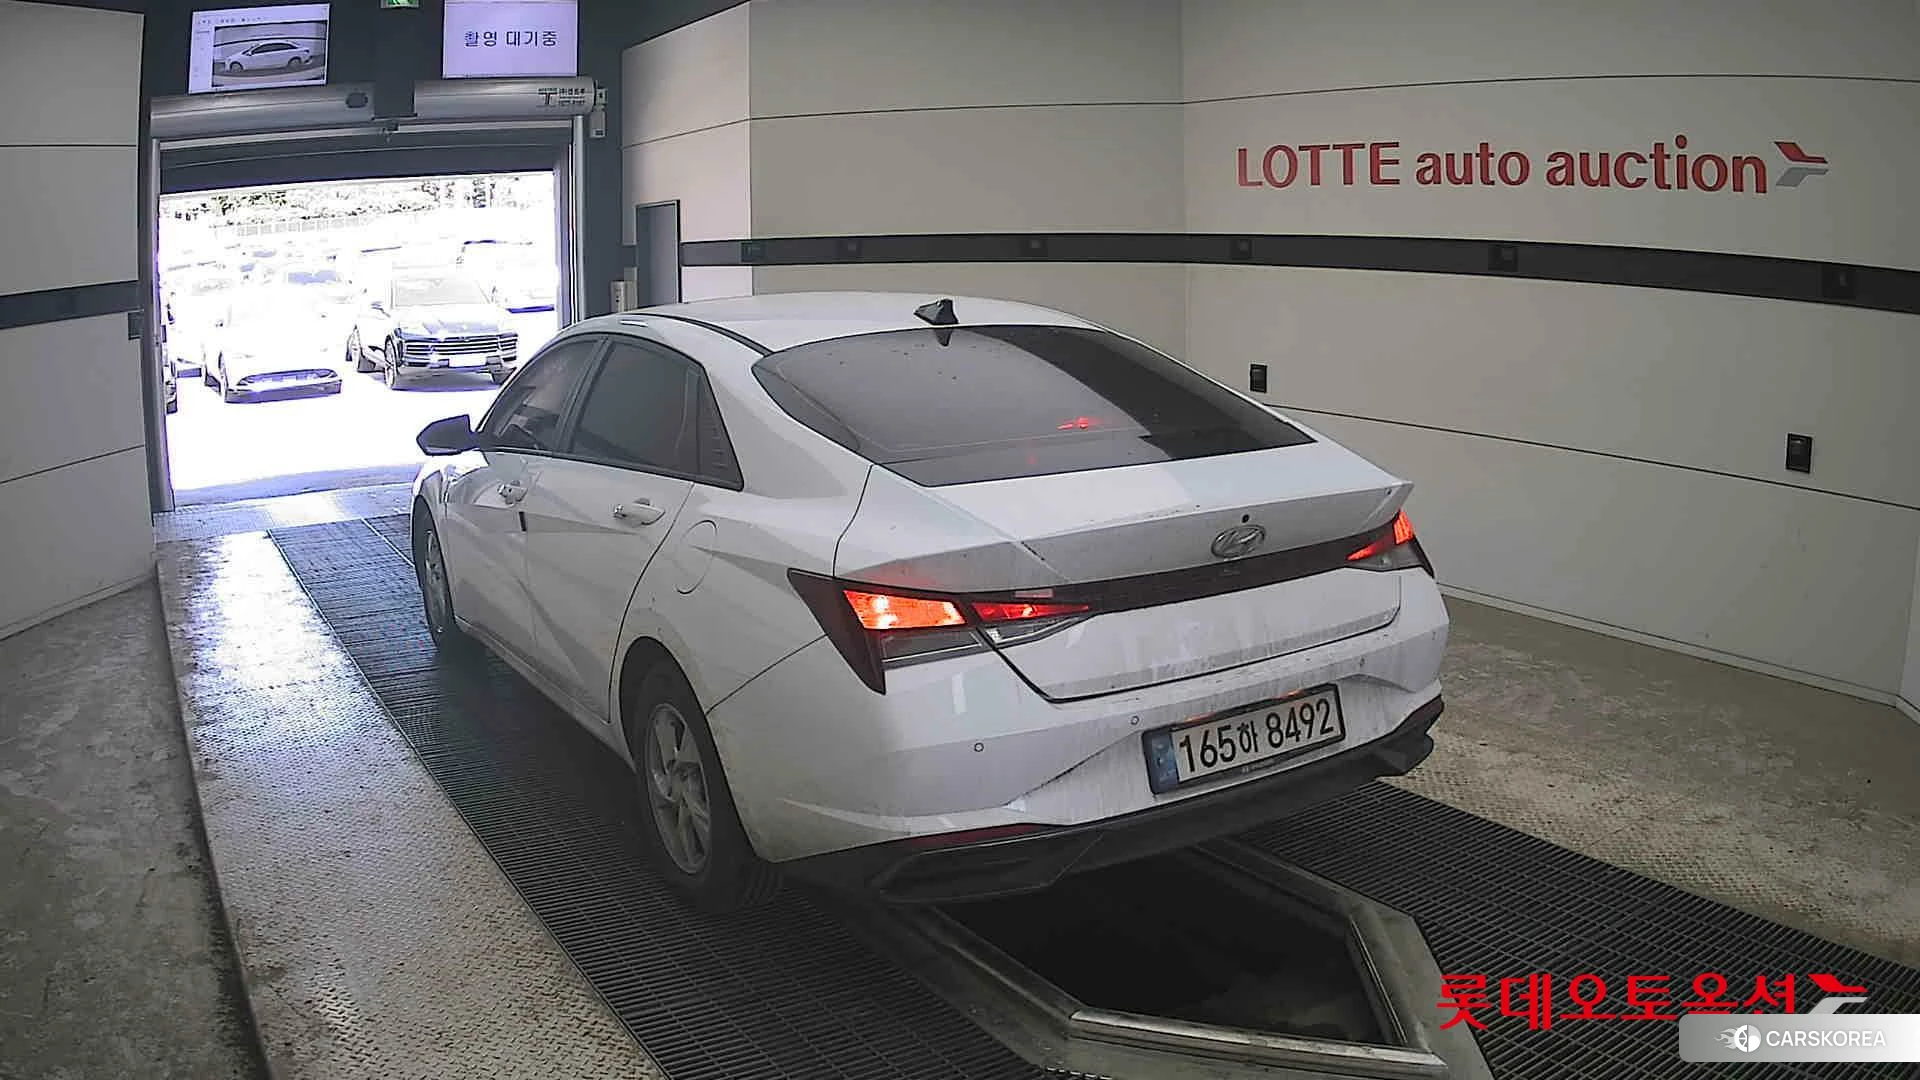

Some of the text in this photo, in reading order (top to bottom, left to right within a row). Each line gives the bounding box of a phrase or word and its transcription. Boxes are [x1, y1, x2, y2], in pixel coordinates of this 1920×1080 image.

[505, 31, 557, 47] 대기중
[1237, 136, 1767, 193] LOTTE auto auction
[1179, 698, 1334, 773] 165하 8492
